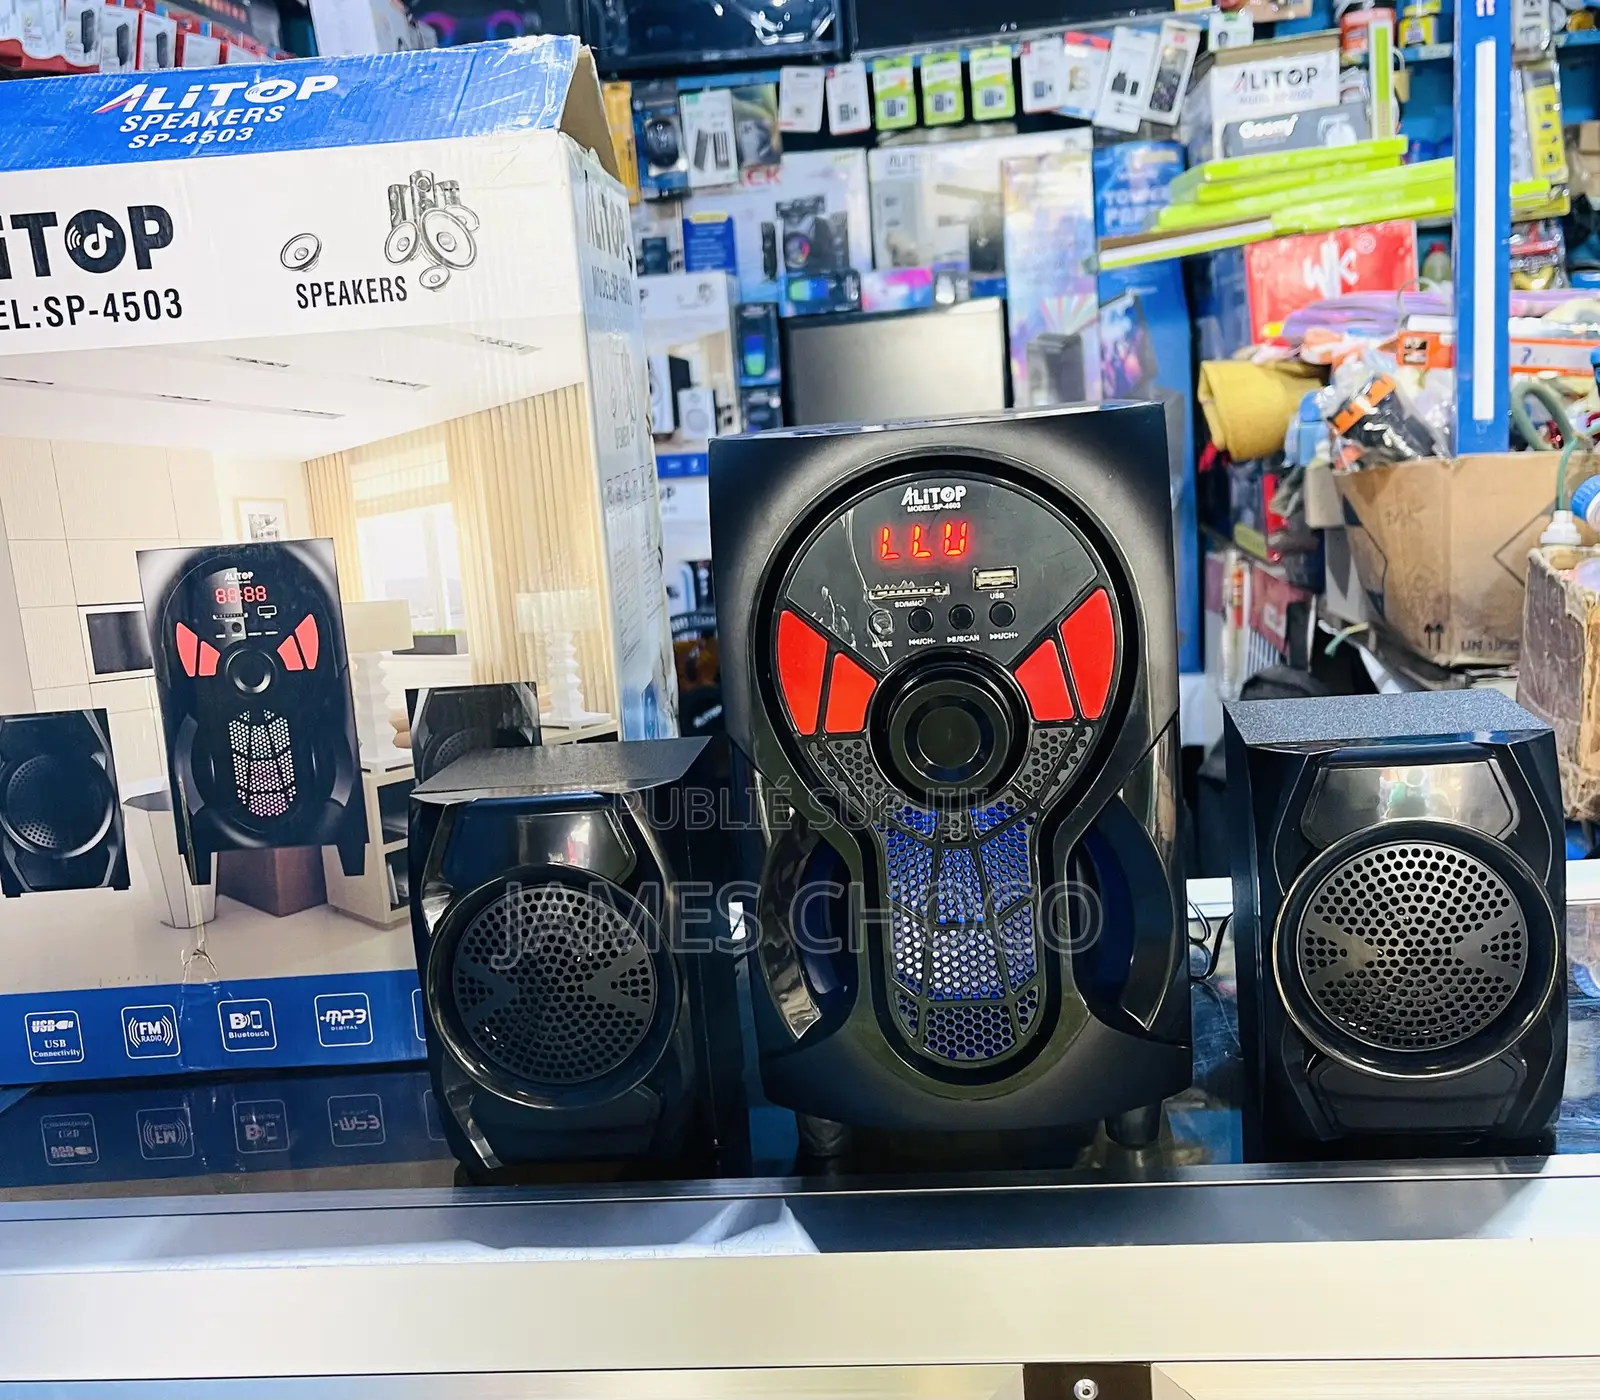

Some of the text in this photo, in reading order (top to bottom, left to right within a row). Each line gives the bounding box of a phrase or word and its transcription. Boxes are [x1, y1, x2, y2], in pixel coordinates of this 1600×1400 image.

[119, 106, 286, 133] SPEAKERS
[128, 127, 254, 149] SP-4503
[297, 276, 408, 310] SPEAKERS
[990, 592, 1005, 600] USB
[139, 1021, 162, 1035] FM
[141, 1034, 162, 1043] RADIO
[228, 1030, 270, 1039] Bluetouch
[44, 1039, 67, 1049] USB
[33, 1048, 81, 1058] Connectivity
